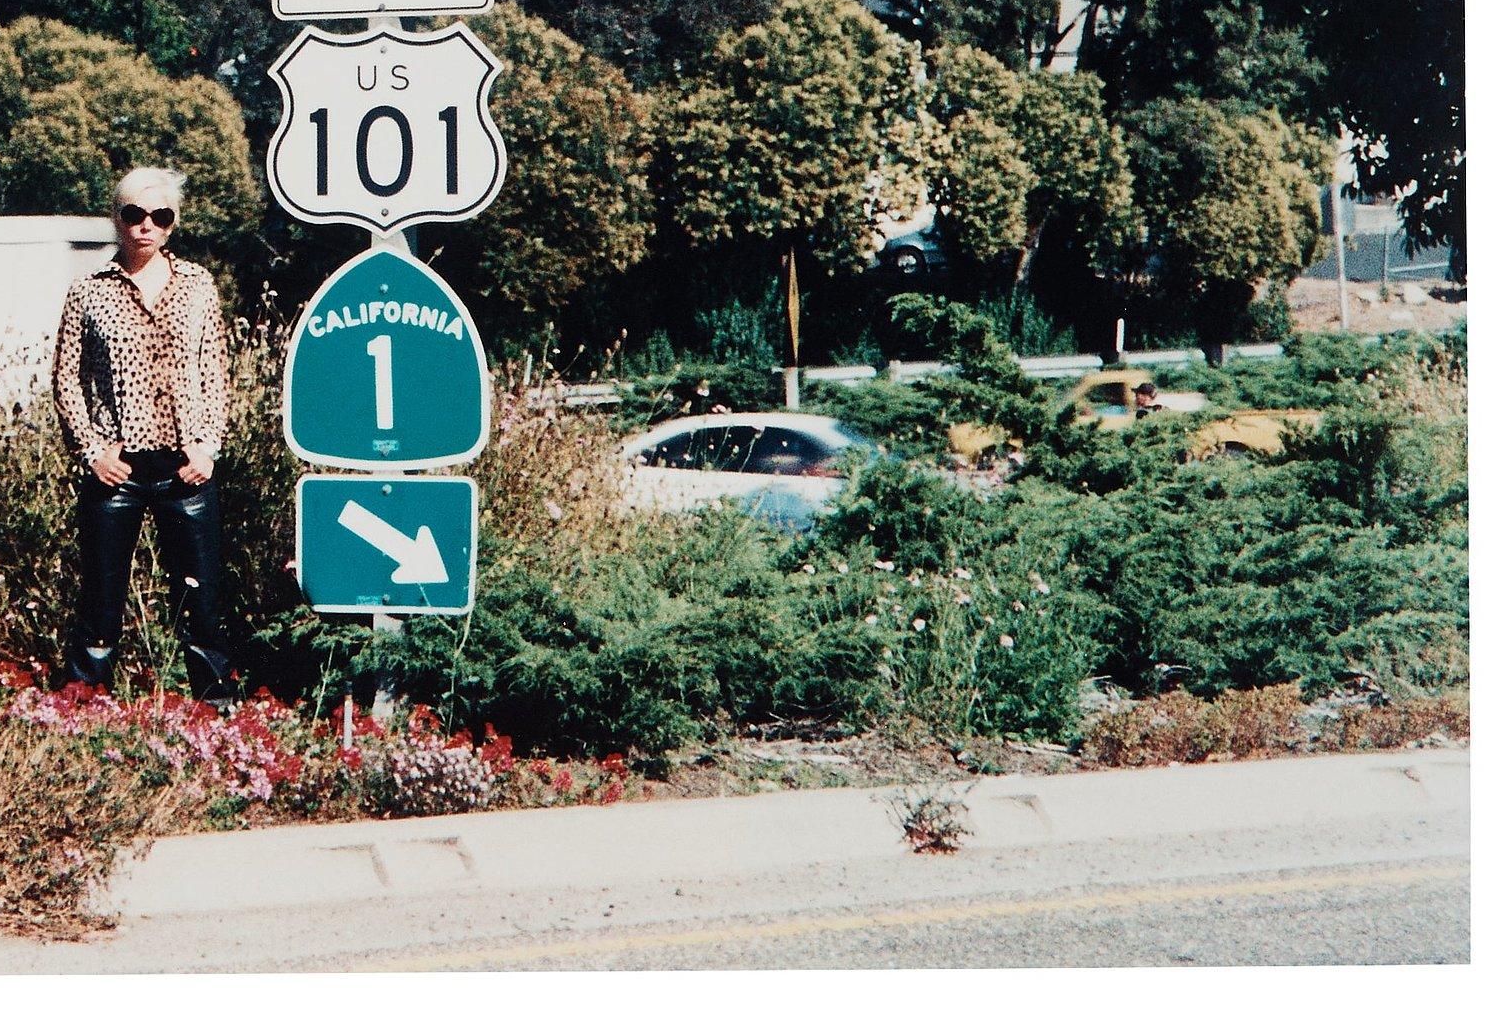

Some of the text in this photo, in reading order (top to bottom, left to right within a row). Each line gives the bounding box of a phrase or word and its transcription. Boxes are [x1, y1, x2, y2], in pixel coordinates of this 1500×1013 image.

[357, 65, 410, 91] US
[309, 105, 459, 197] 101
[308, 301, 463, 340] CALIFORNIA
[366, 335, 394, 430] 1
